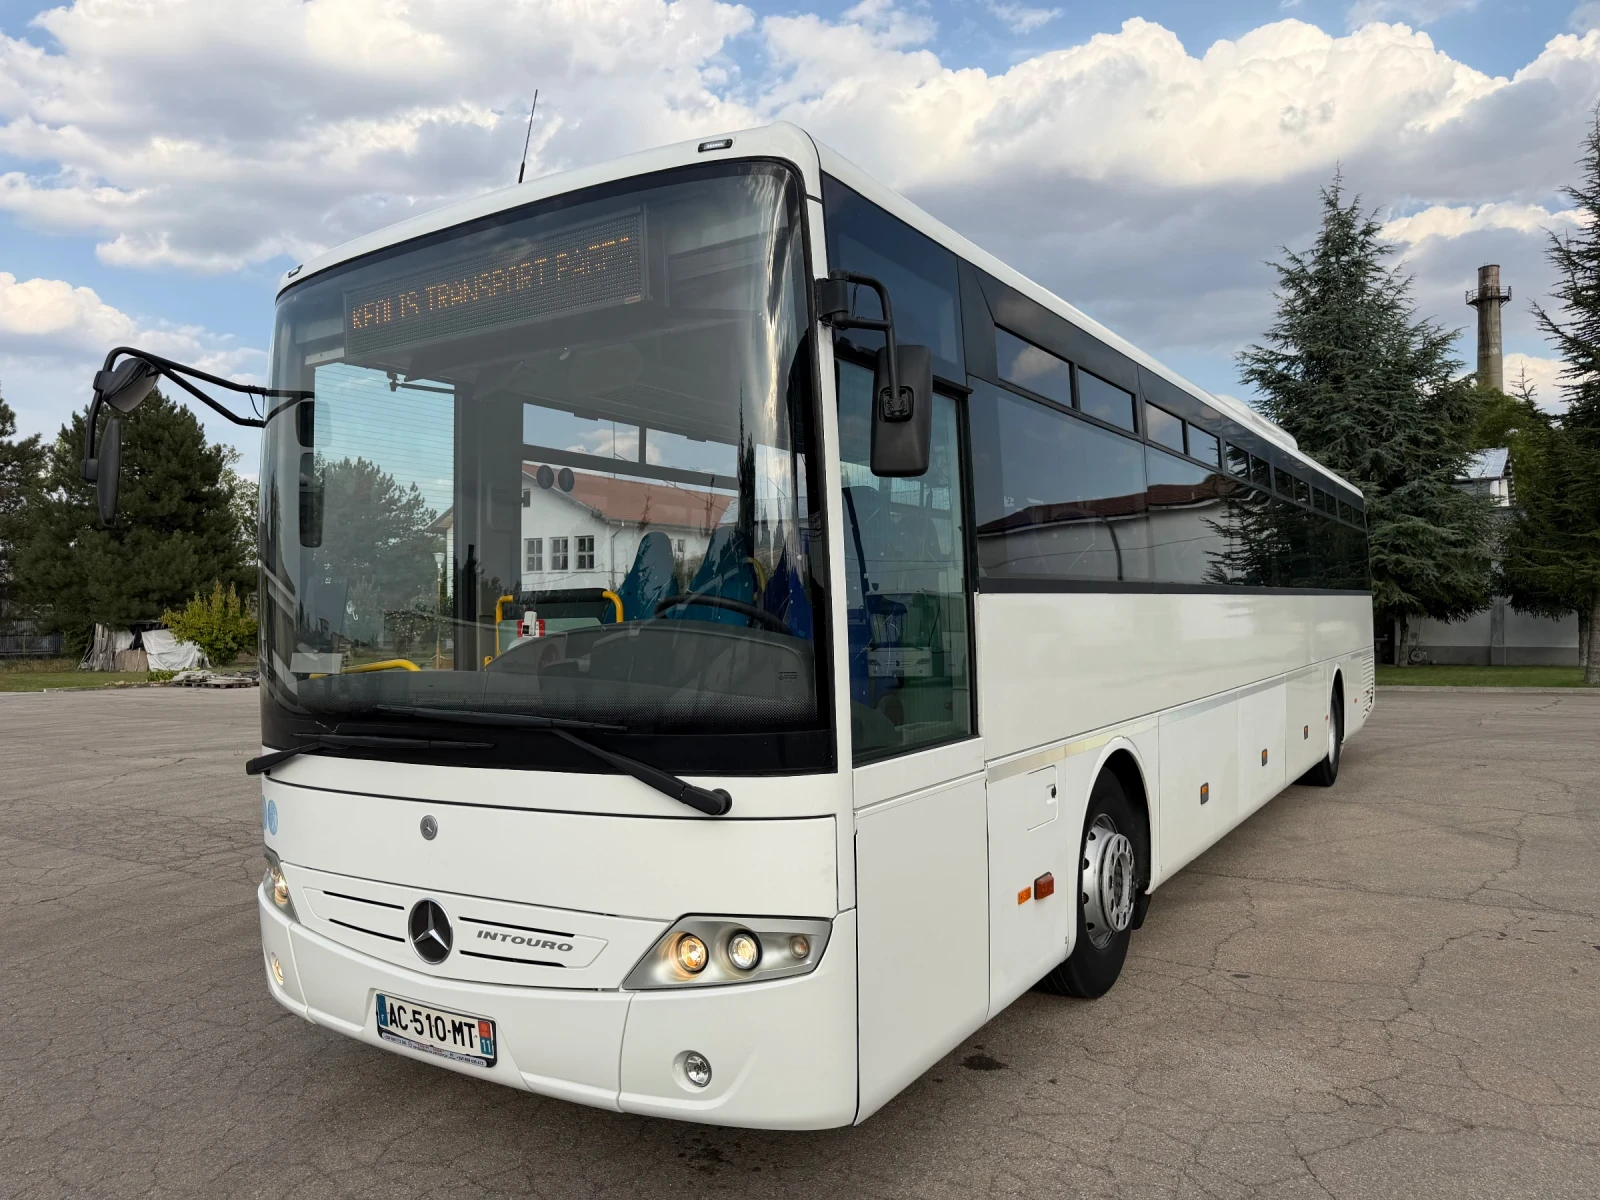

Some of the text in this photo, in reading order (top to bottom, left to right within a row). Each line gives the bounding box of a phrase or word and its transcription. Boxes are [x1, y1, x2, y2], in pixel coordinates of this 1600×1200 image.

[425, 257, 548, 311] TRANSPORT
[476, 930, 574, 952] INTOURO
[388, 1002, 476, 1049] AC-510-MT
[481, 1038, 492, 1054] 11
